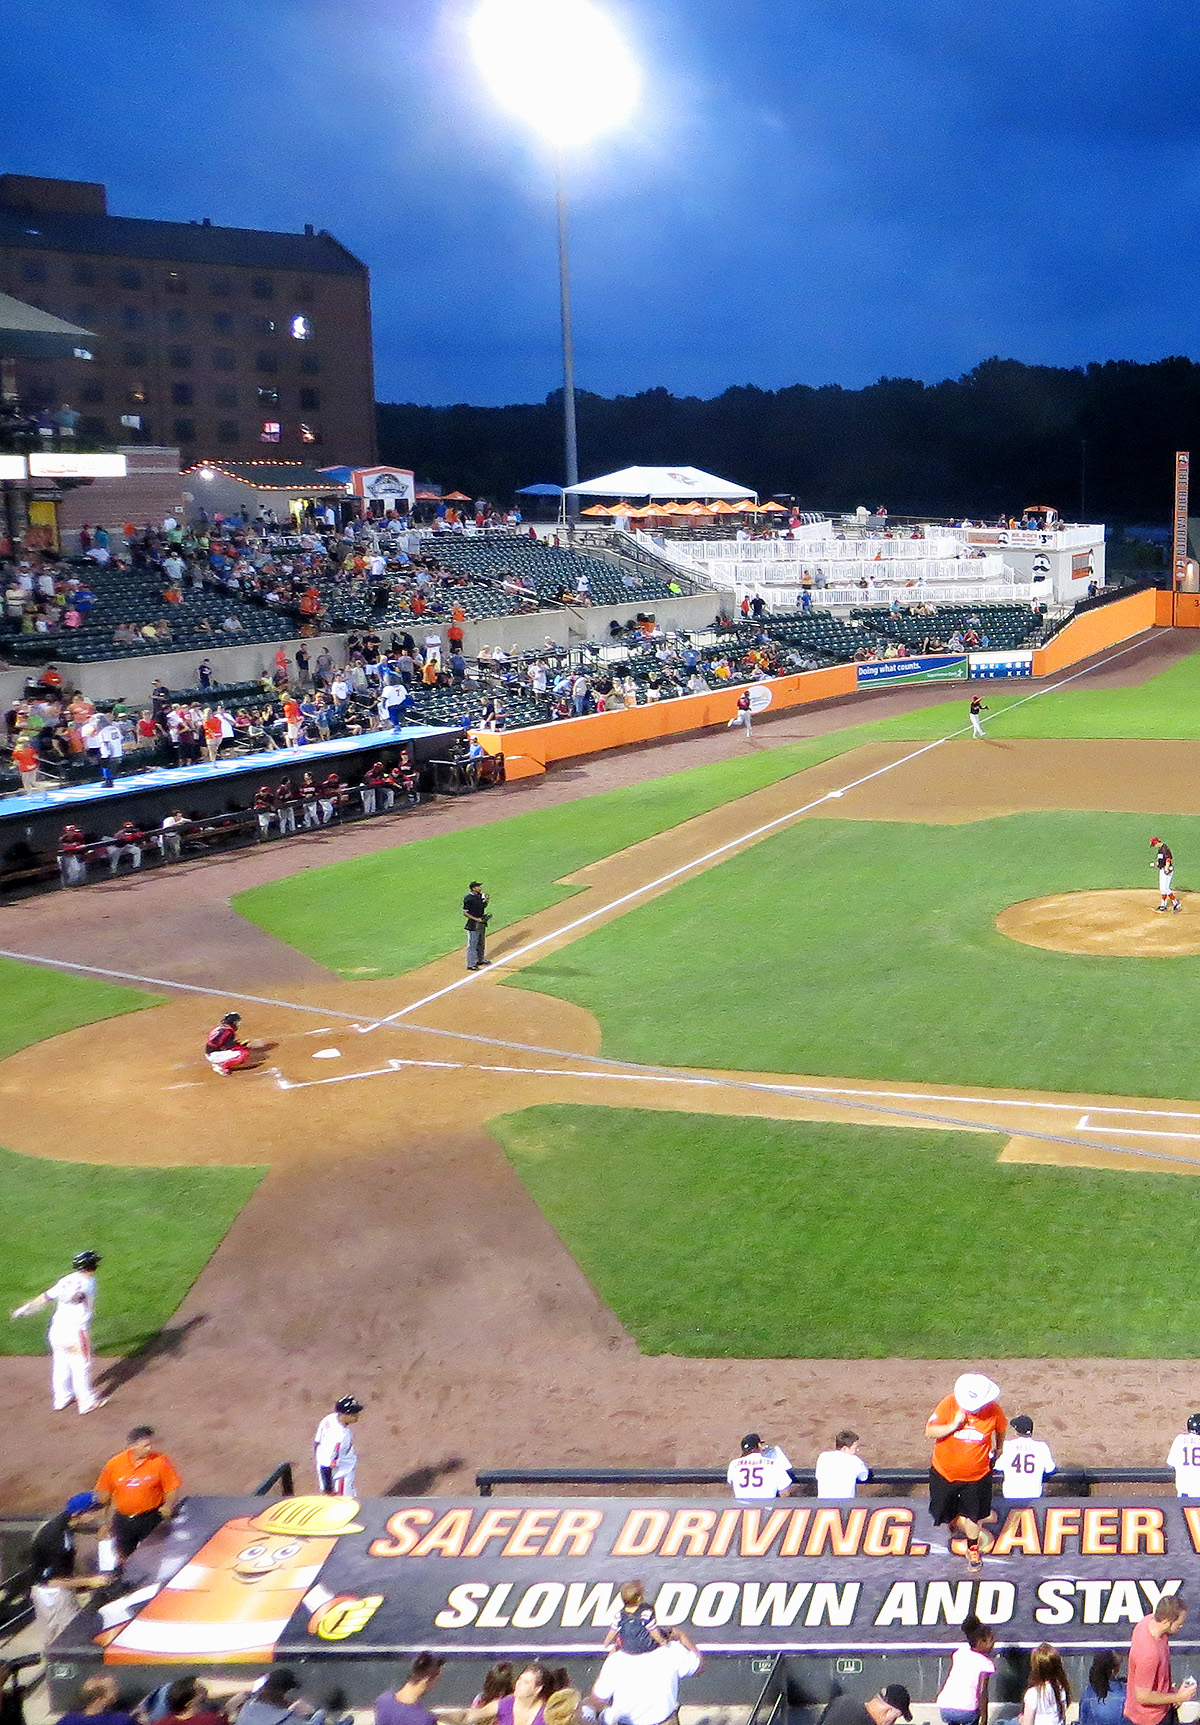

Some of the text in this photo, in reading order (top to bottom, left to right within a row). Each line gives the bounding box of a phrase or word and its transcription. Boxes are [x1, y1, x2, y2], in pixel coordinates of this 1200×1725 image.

[858, 662, 922, 676] Doing what counts.
[1011, 1453, 1035, 1474] 46
[739, 1467, 764, 1488] 35
[369, 1507, 605, 1558] SAFER
[610, 1506, 931, 1557] DRIVING.
[434, 1581, 625, 1629] SLOW
[653, 1581, 862, 1628] DOWN
[874, 1580, 1015, 1627] AND
[1035, 1579, 1183, 1625] STAY
